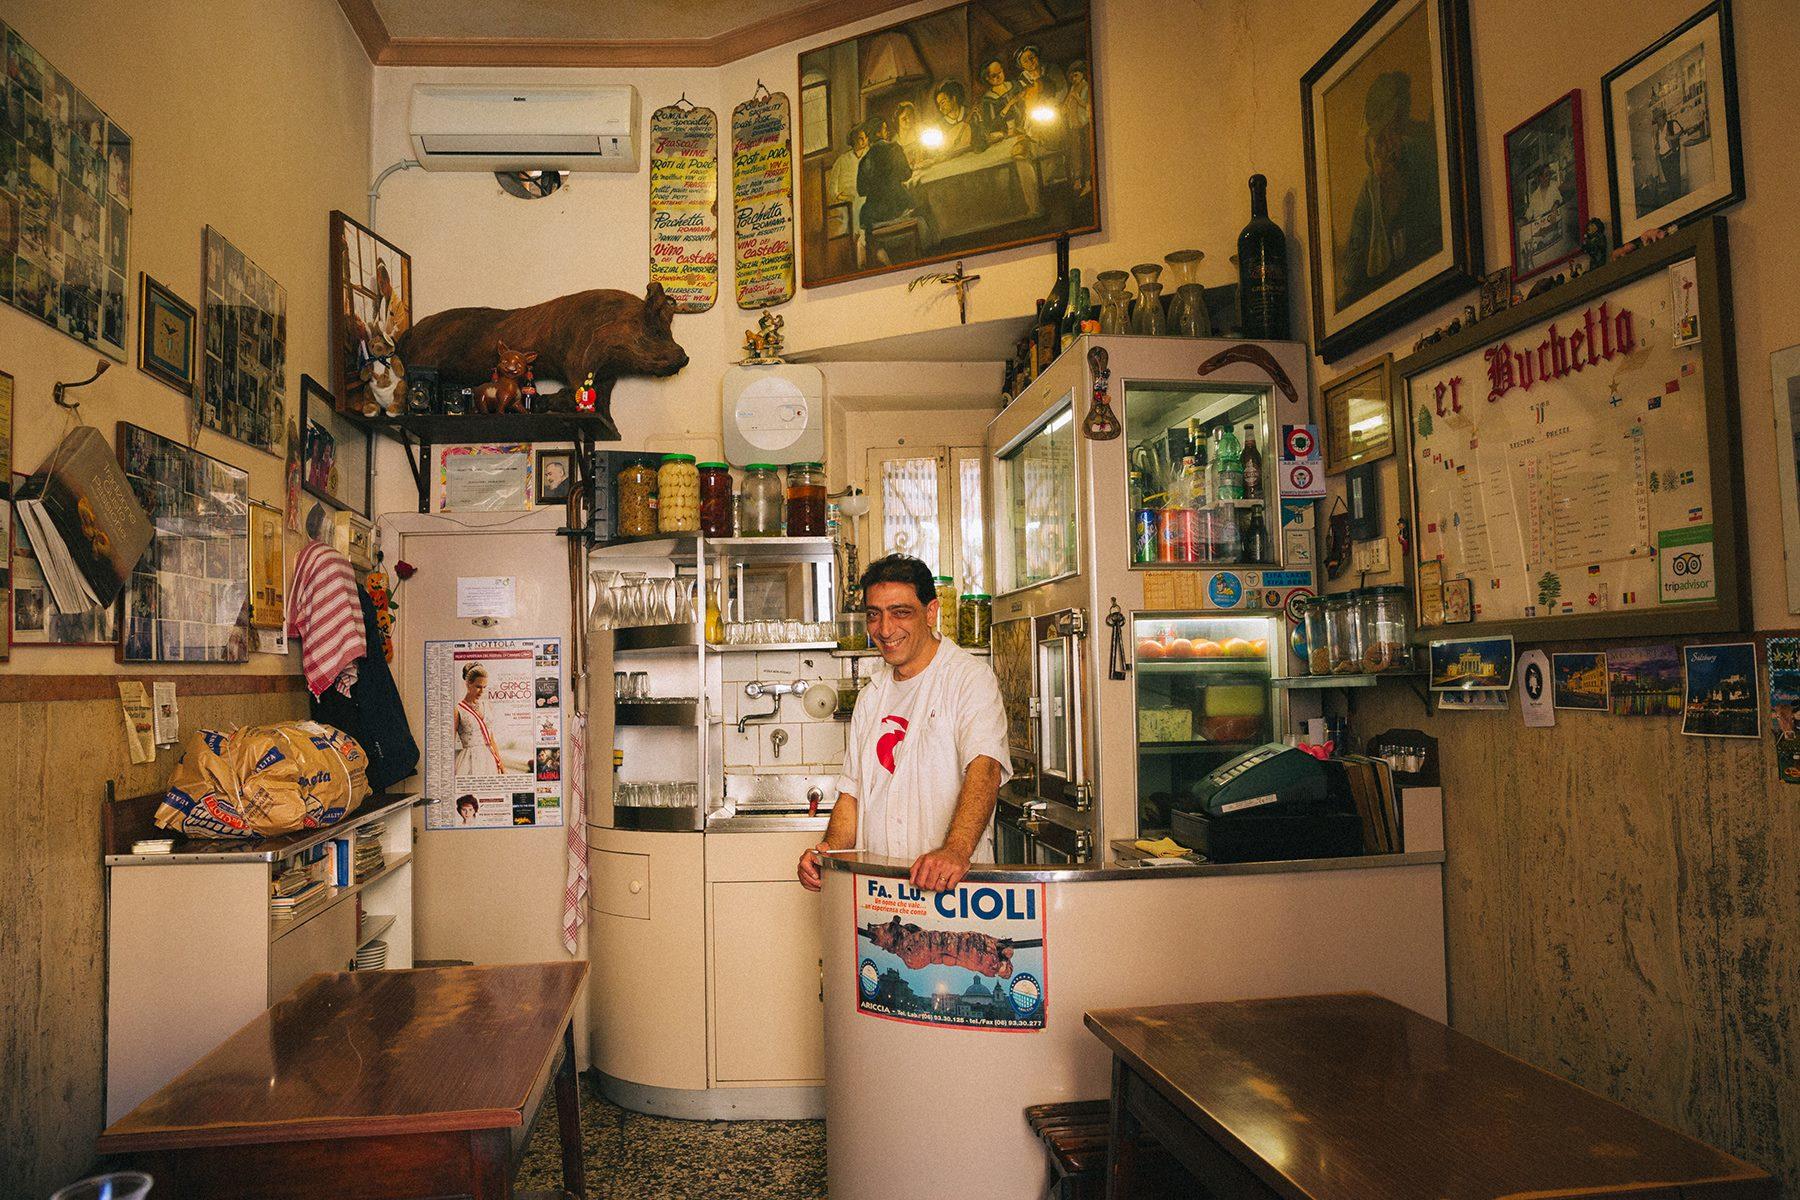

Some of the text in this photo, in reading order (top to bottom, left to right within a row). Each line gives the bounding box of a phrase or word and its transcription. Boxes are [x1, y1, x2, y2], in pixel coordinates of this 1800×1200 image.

[681, 149, 708, 157] WINE
[688, 158, 714, 169] PORC
[653, 211, 706, 230] Porchetta
[736, 202, 783, 229] Porchetta
[752, 218, 786, 231] ROMANA
[653, 242, 684, 256] Vino
[737, 239, 757, 250] VINO
[651, 263, 679, 273] SPEZIAL
[1434, 301, 1638, 418] er Buchetto
[1664, 579, 1709, 593] tripadvisor
[474, 640, 516, 648] NOTTOLA
[1691, 652, 1717, 665] Salzburg
[500, 681, 531, 691] GRACE
[488, 691, 532, 700] MONACO
[867, 880, 1036, 921] FA. LU. CIOLI
[899, 907, 909, 915] che
[860, 1001, 890, 1014] ARICCIA
